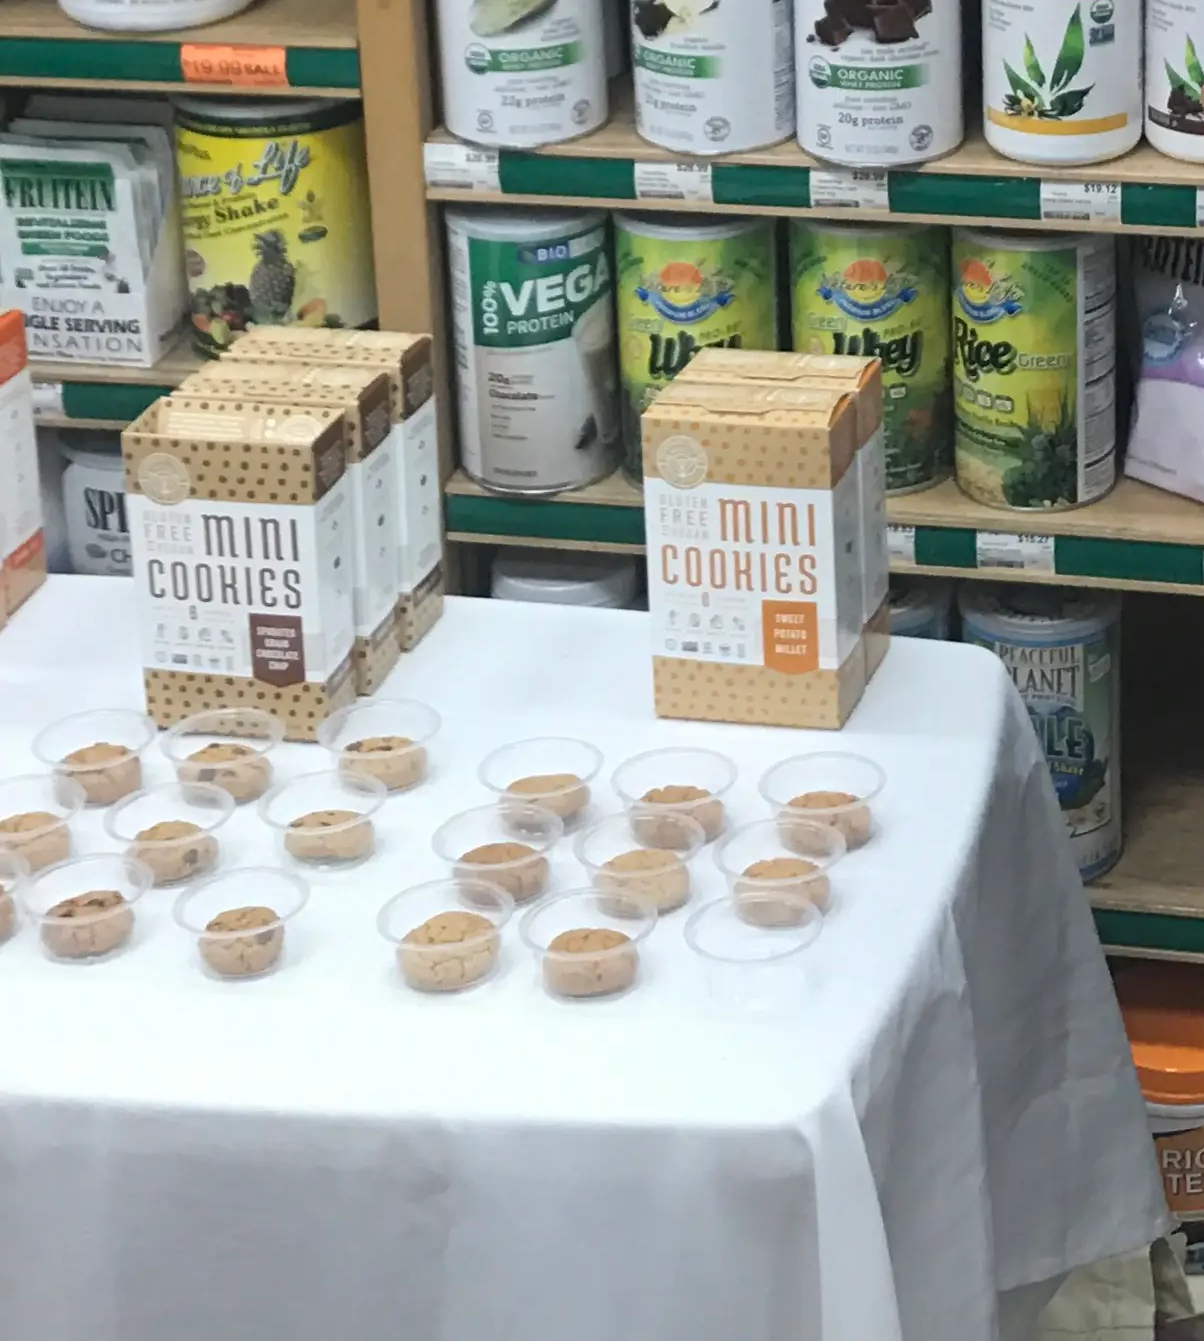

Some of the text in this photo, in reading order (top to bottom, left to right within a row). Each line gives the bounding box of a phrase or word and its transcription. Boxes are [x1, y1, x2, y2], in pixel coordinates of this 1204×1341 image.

[499, 50, 565, 64] ORGANIC
[837, 68, 904, 82] ORGANIC
[838, 112, 904, 127] 20g protein
[246, 140, 310, 195] Life
[215, 197, 280, 225] Shake
[500, 254, 611, 316] VEGA
[31, 296, 106, 314] ENJOY A
[482, 279, 500, 335] 100%
[65, 318, 141, 334] SERVING
[507, 310, 575, 335] PROTEIN
[954, 315, 1017, 383] Rice
[1018, 352, 1065, 368] Green
[660, 507, 708, 527] FREE
[661, 543, 818, 596] COOKIES
[148, 558, 302, 610] COOKIES
